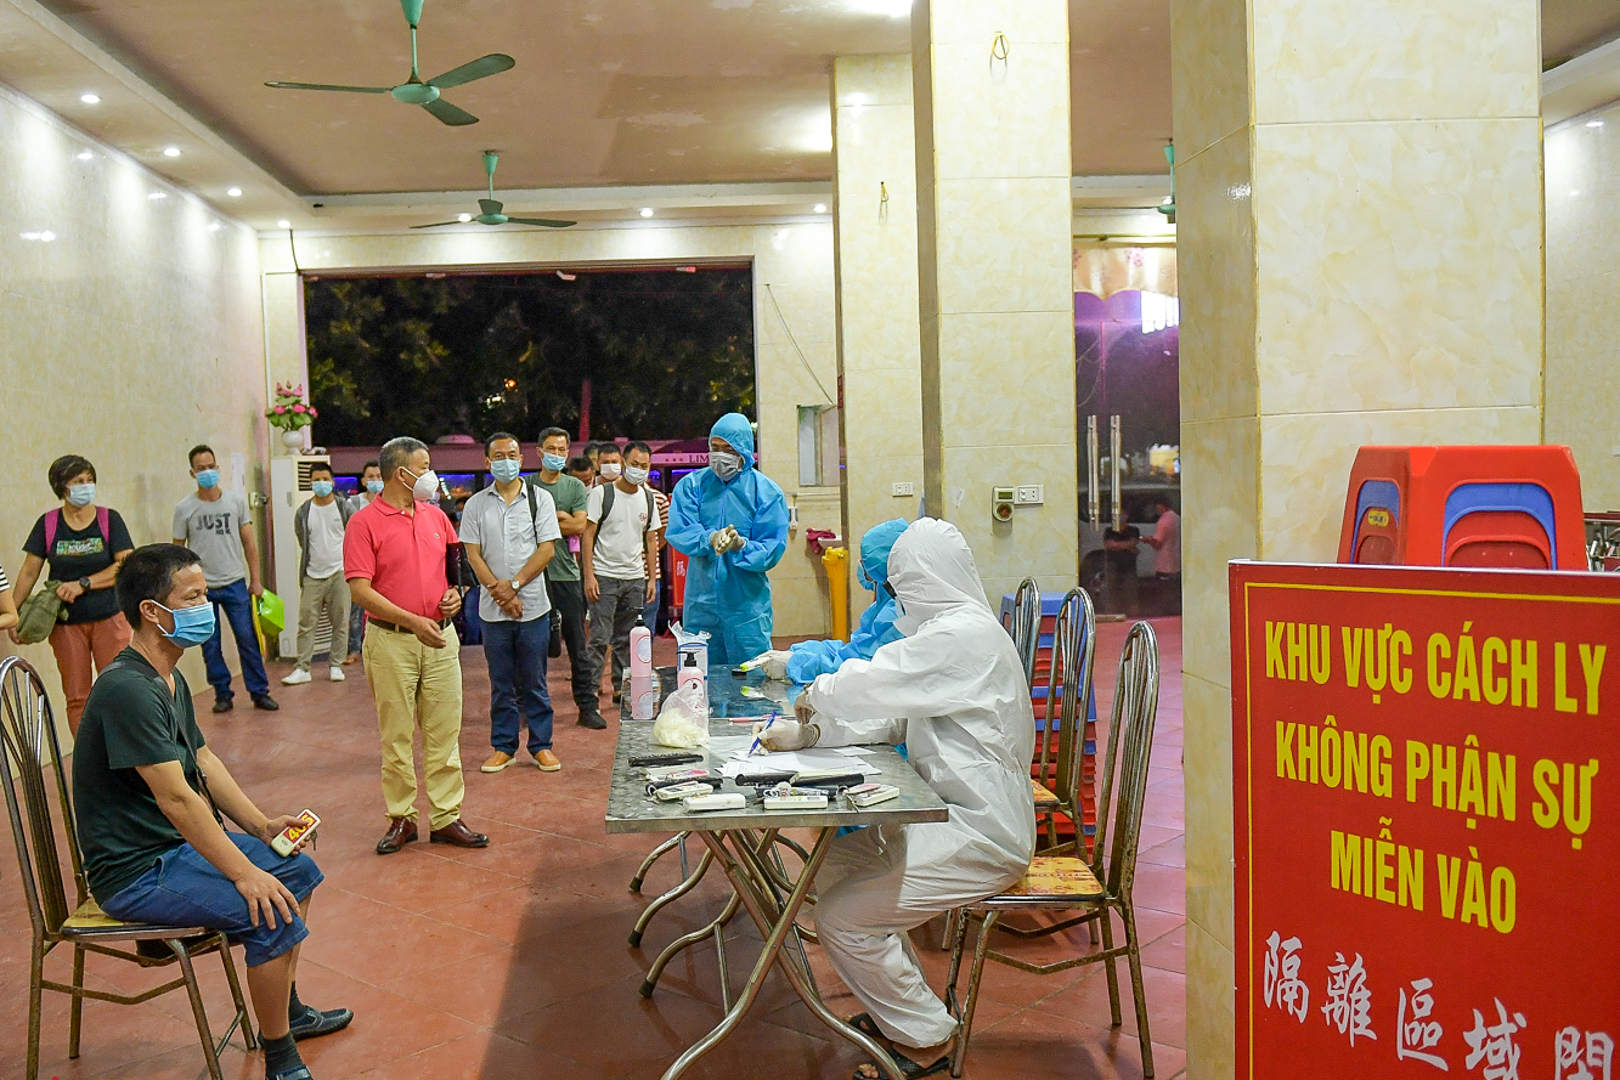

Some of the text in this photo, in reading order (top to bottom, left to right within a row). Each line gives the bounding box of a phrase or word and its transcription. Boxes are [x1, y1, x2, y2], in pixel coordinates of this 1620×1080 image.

[196, 513, 230, 531] JUST
[1265, 620, 1607, 716] KHU VỰC CÁCH LY
[1275, 714, 1599, 850] KHÔNG PHẬN SỰ
[1330, 816, 1516, 934] MIỄN VÀO
